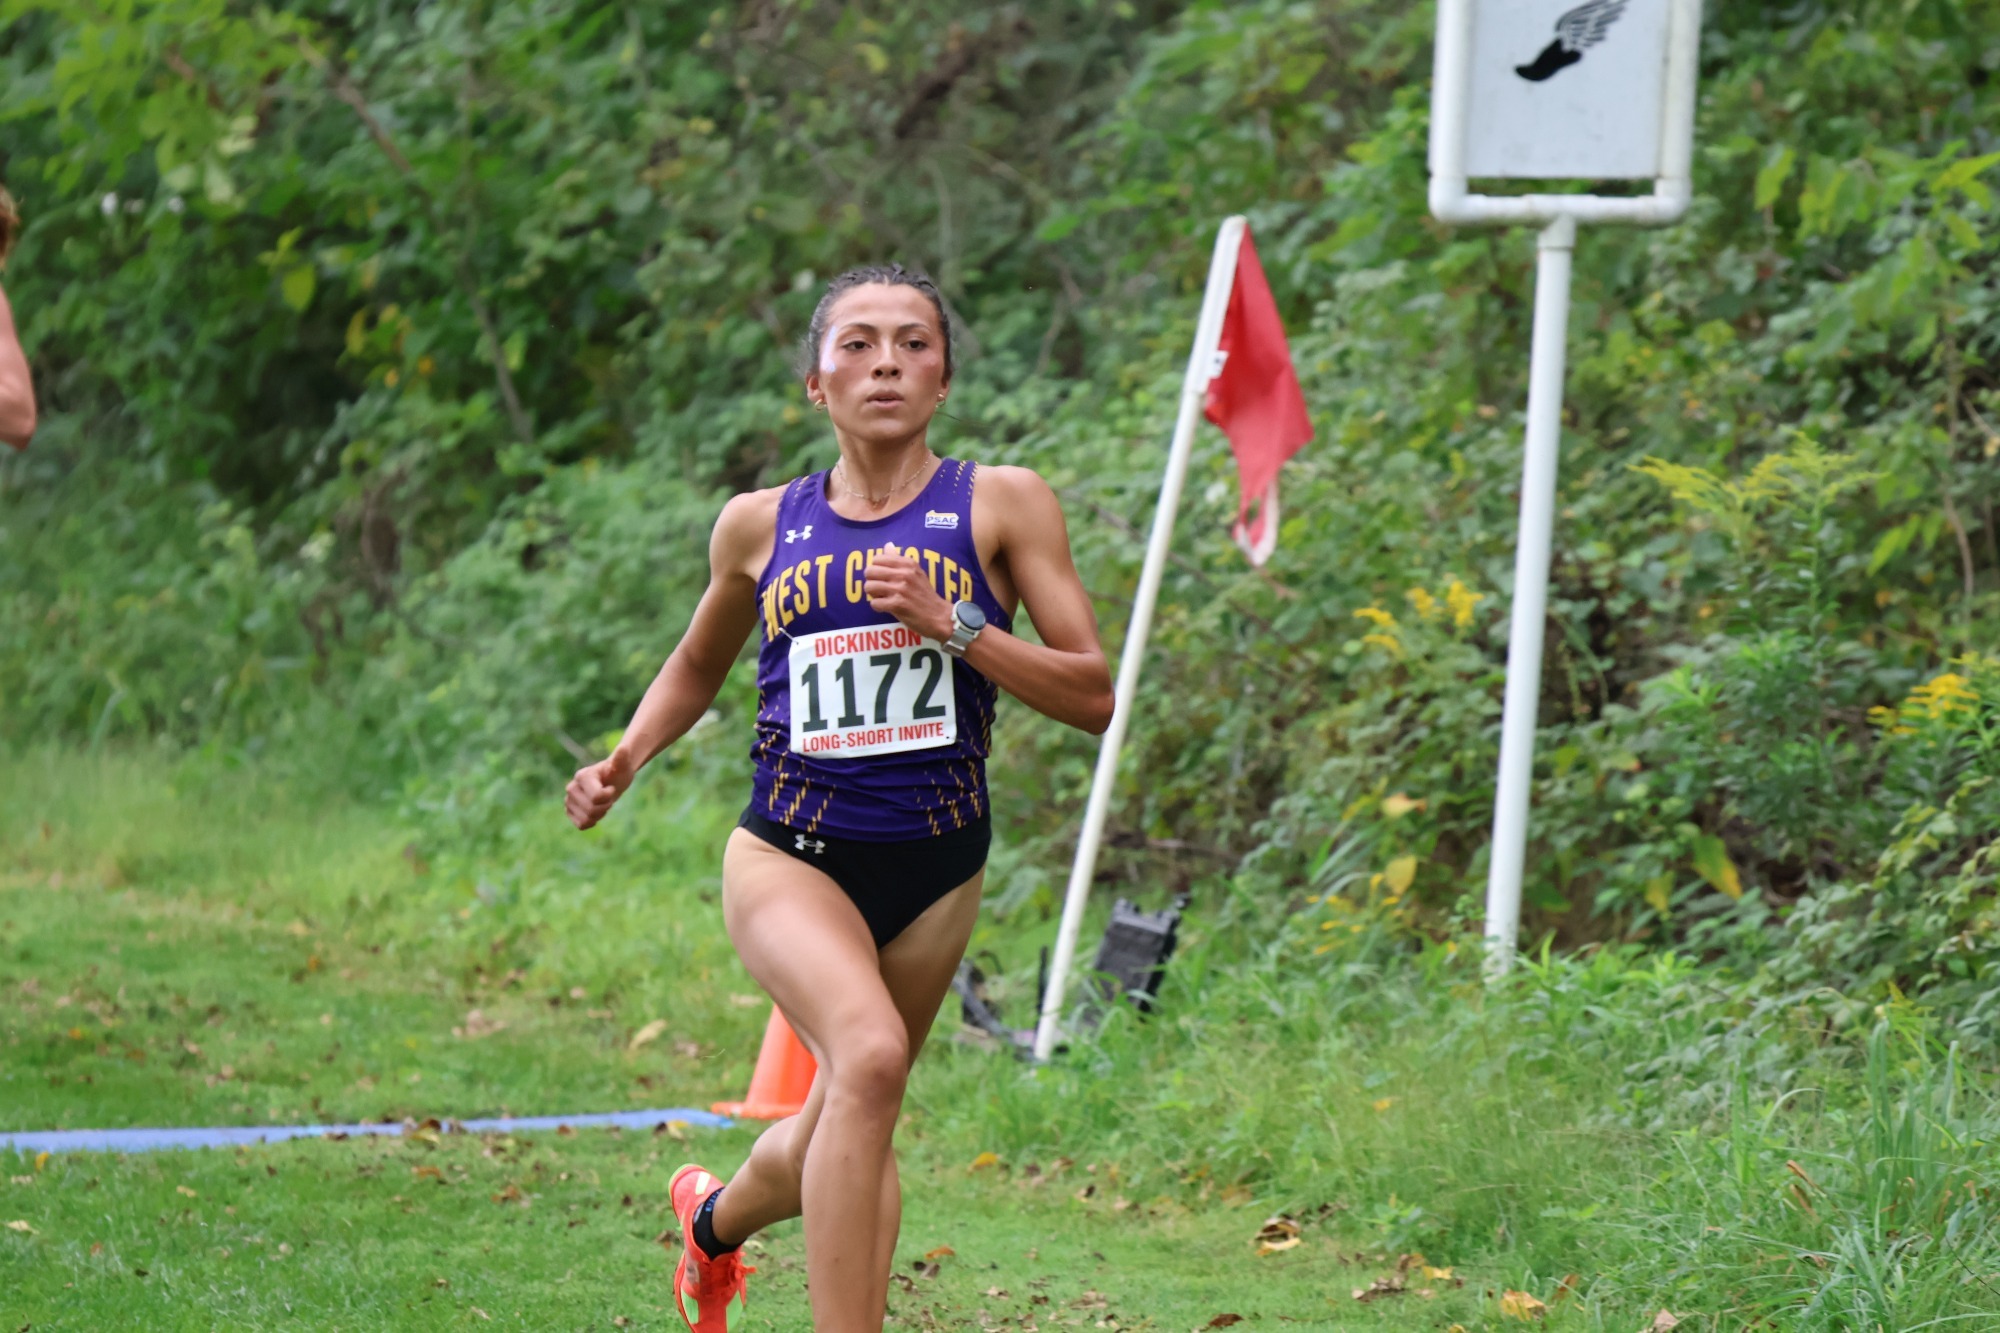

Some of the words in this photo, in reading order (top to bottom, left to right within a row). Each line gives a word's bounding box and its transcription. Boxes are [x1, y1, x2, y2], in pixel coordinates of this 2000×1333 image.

[761, 554, 833, 642] WEST
[845, 546, 973, 604] CTER
[815, 627, 922, 657] DICKINSON
[801, 648, 946, 733] 1172
[803, 728, 893, 752] LONG-SHORT
[899, 722, 944, 741] INVITE
